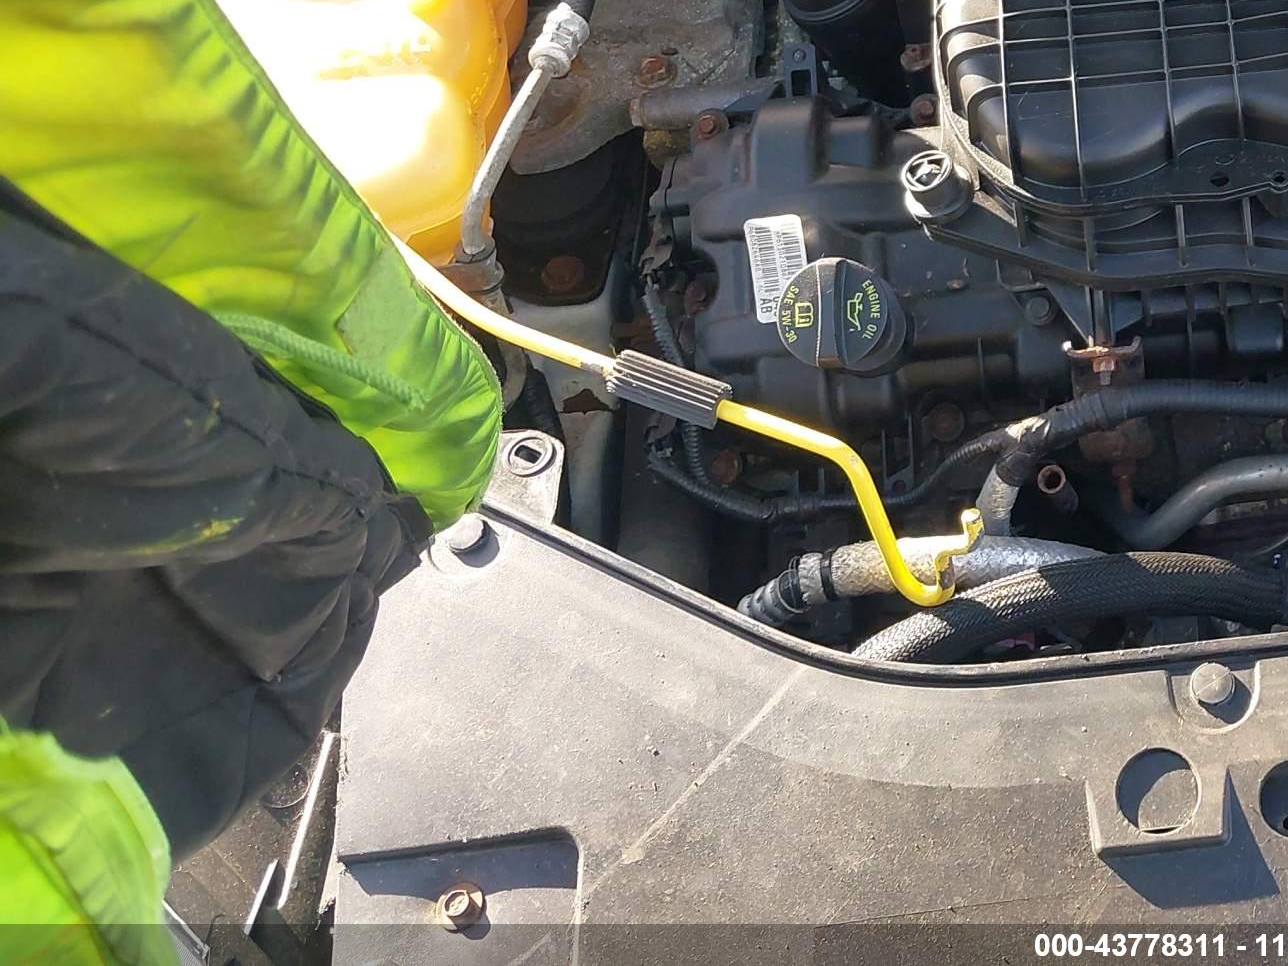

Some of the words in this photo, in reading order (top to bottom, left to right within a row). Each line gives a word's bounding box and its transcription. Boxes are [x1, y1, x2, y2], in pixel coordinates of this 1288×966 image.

[759, 298, 773, 314] AB
[783, 285, 800, 306] SAE
[862, 279, 881, 319] ENGINE
[781, 310, 798, 343] 5W-30
[861, 324, 878, 340] OIL
